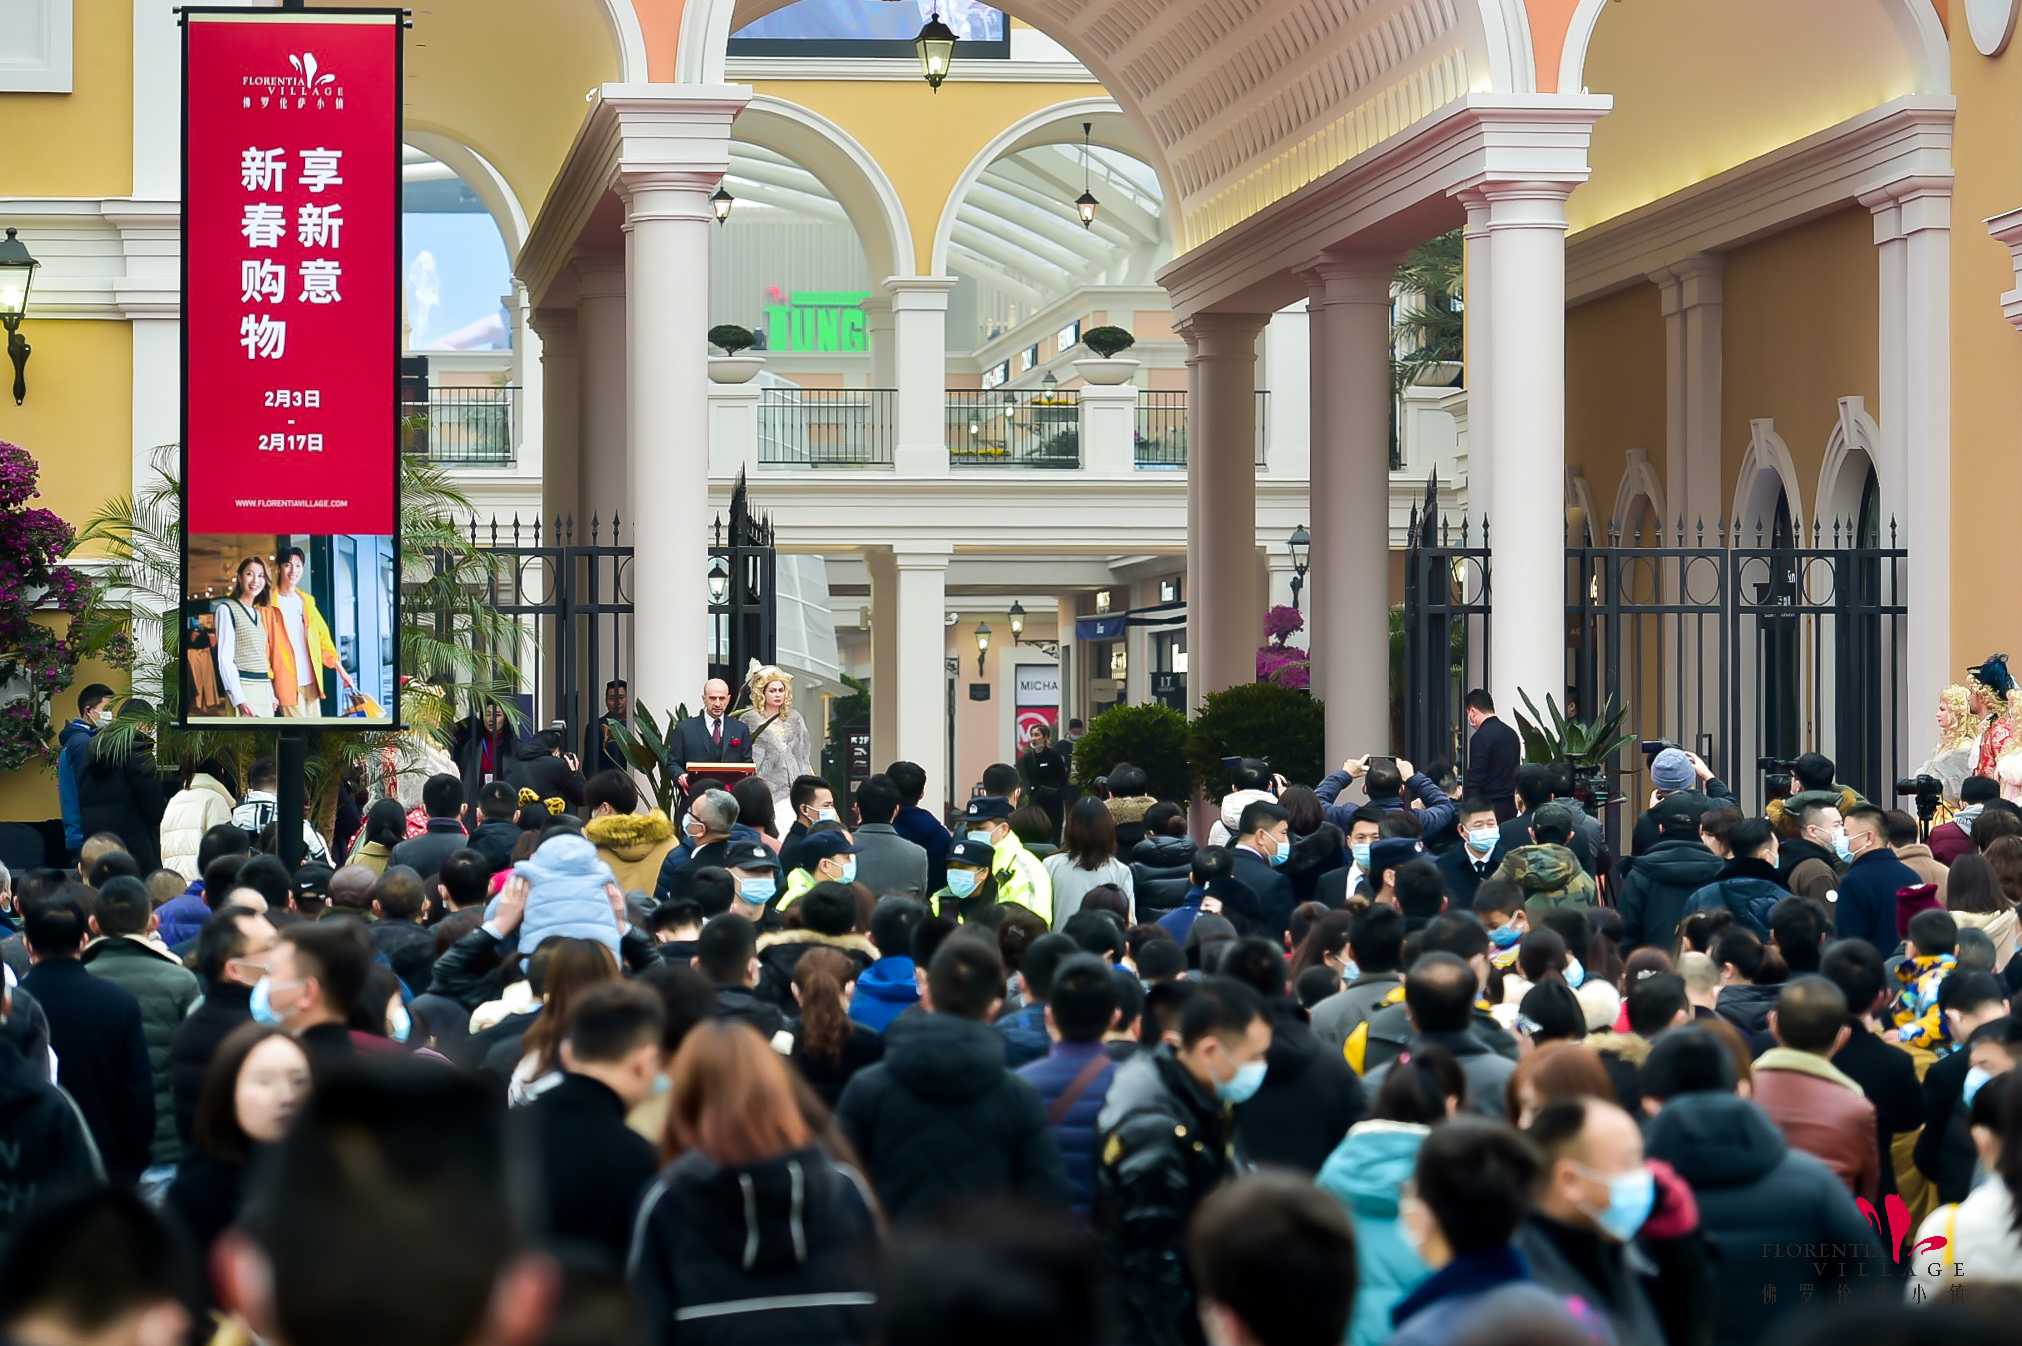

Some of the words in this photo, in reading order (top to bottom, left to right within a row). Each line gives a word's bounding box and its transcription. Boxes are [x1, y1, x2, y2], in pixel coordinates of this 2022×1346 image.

[243, 76, 305, 86] FLORENTIA
[267, 86, 343, 96] VILLAGE
[298, 146, 344, 304] 享新意
[240, 146, 287, 360] 新春购物
[763, 305, 871, 352] TUNG
[264, 389, 320, 408] 2月3日
[258, 433, 324, 452] 2月17日
[235, 499, 348, 508] WWW.FLORENTIAVILLAGE.COM
